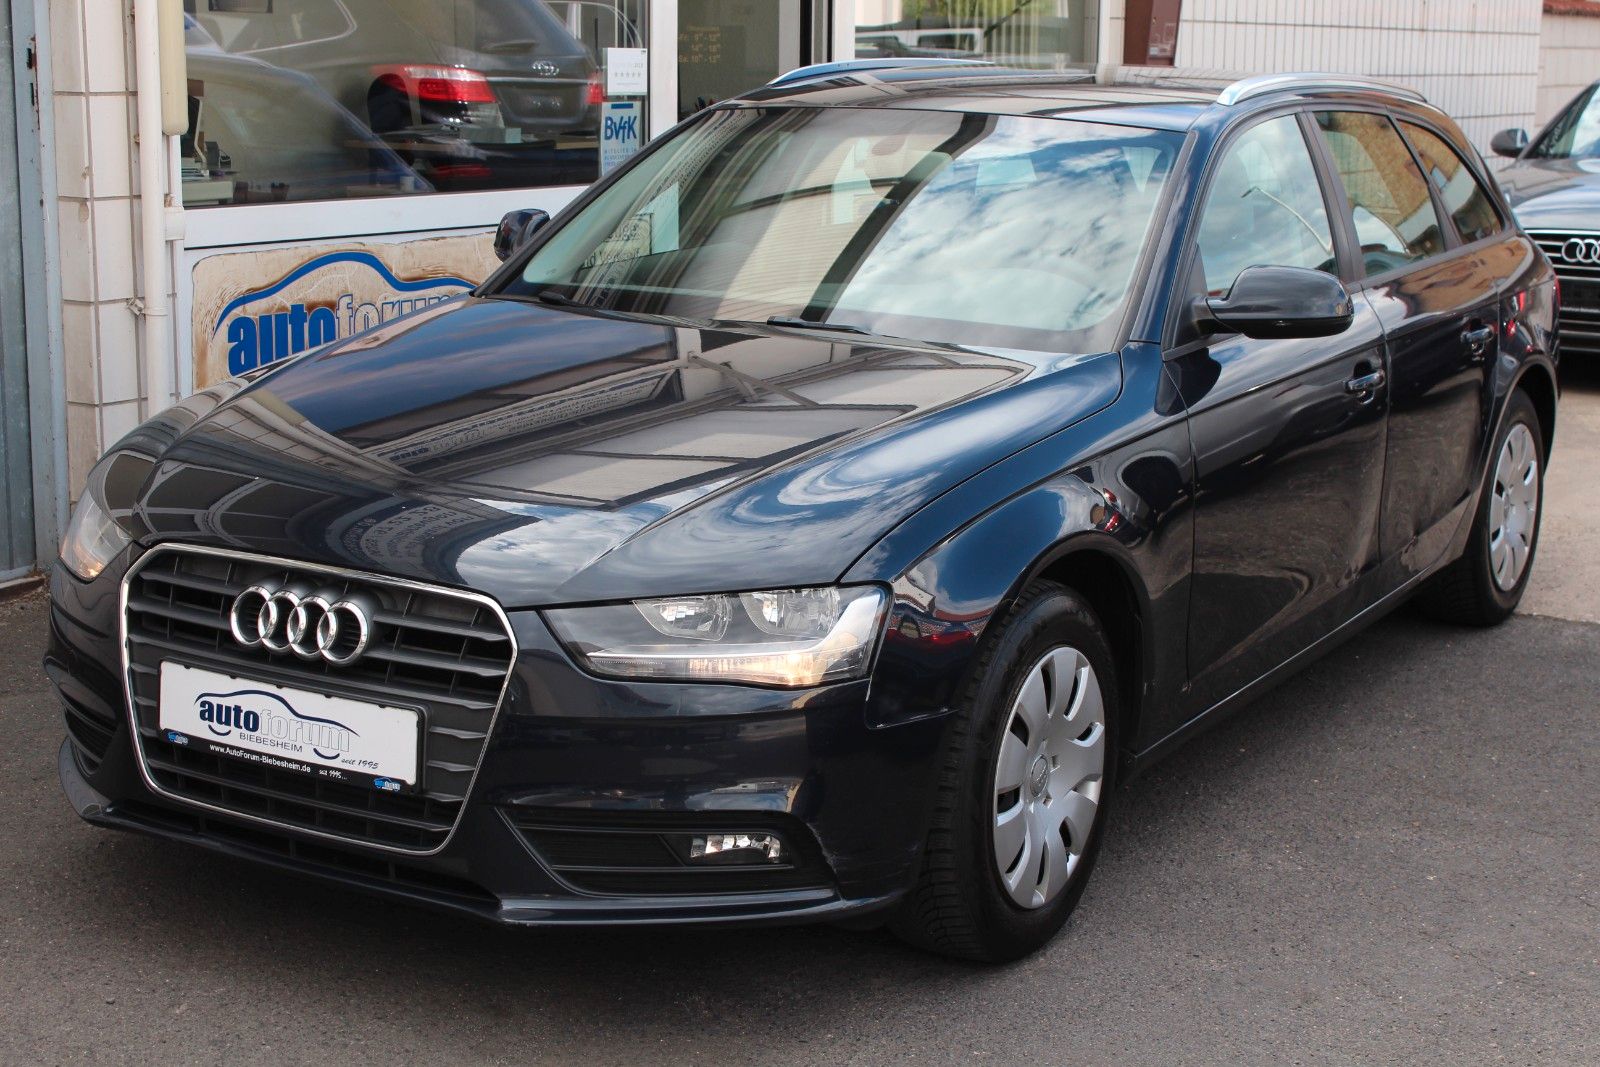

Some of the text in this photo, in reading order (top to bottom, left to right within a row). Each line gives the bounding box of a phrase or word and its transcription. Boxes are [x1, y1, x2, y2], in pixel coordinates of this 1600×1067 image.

[604, 115, 638, 143] BVfK
[227, 293, 451, 377] autofo
[239, 732, 303, 752] BIEBESHEIM
[209, 744, 311, 773] www.AutoForum-Biebesheim.de
[358, 759, 379, 770] 1995
